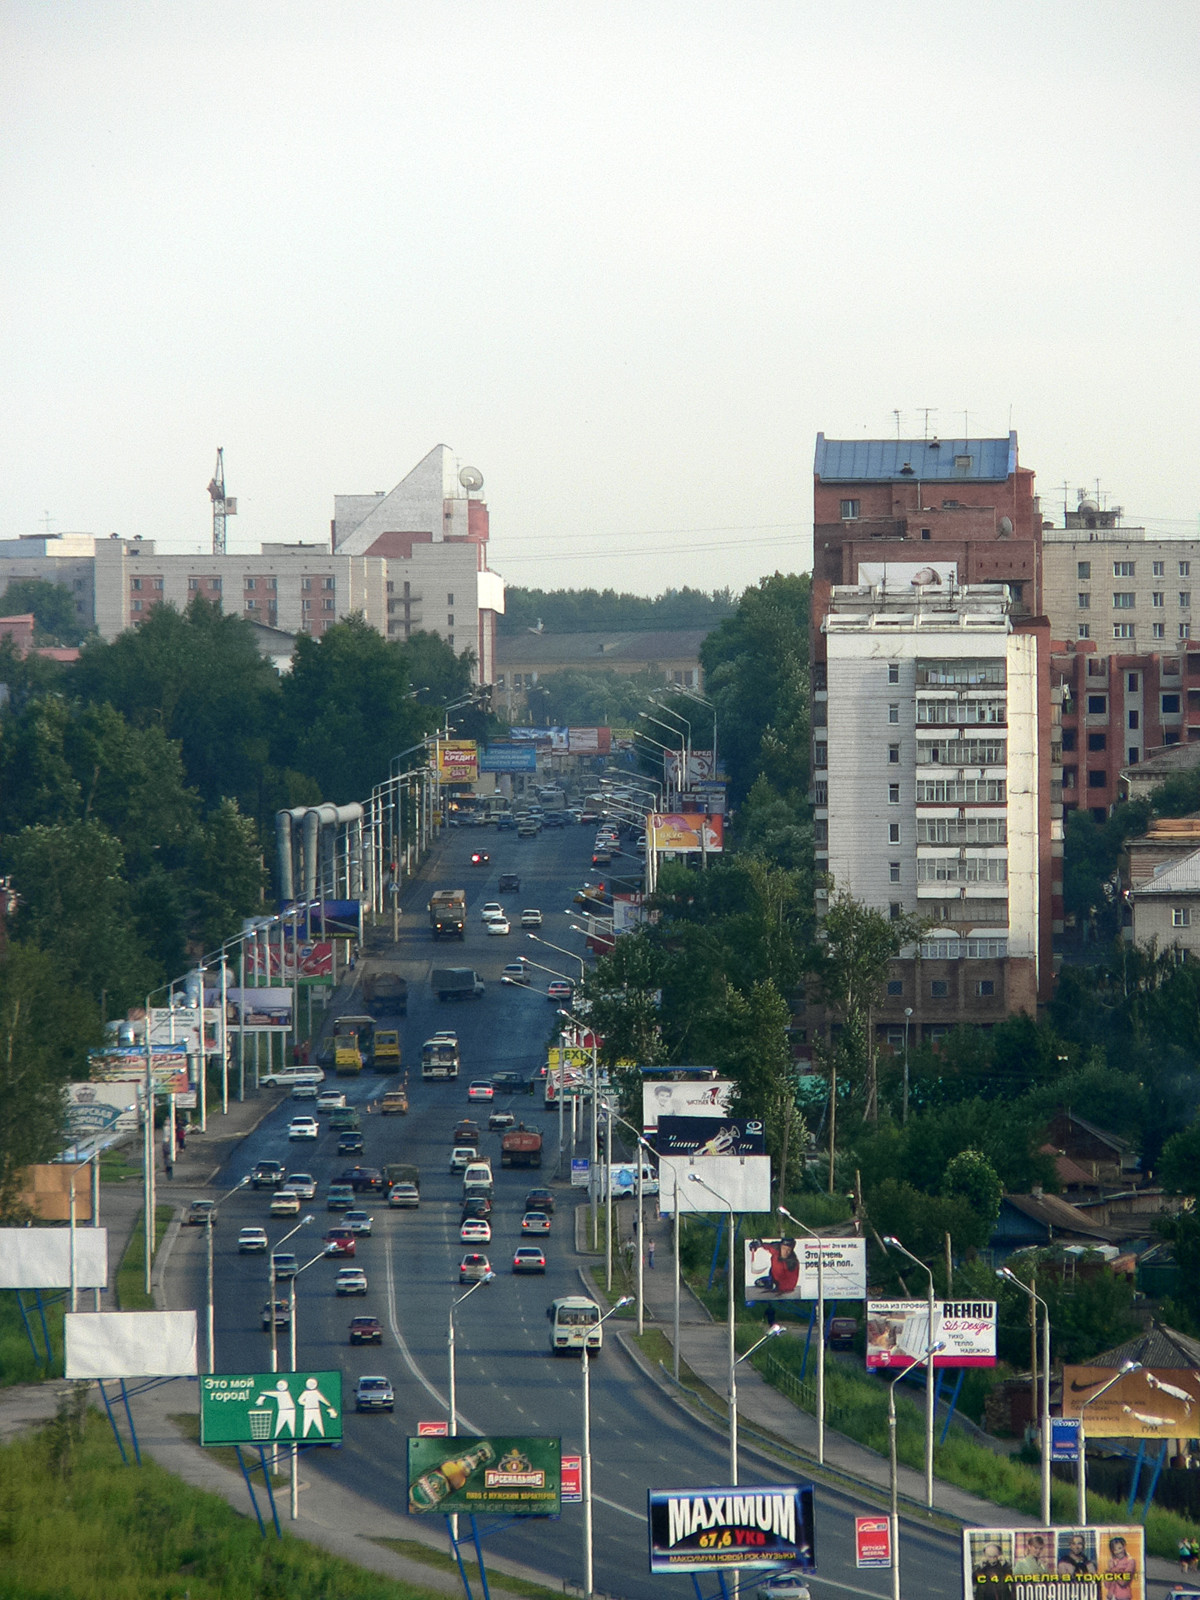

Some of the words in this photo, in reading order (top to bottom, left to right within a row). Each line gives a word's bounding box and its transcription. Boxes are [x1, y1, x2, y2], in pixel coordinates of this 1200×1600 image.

[805, 1250, 819, 1259] Это
[804, 1260, 835, 1269] ровый
[943, 1303, 993, 1318] REHAU
[204, 1378, 228, 1389] Это
[230, 1377, 255, 1388] мой
[210, 1389, 250, 1402] город!
[668, 1494, 796, 1548] MAXIMUM
[699, 1531, 732, 1549] 67,6
[734, 1530, 766, 1545] УКВ
[669, 1554, 716, 1562] МАКСИМУМ
[717, 1552, 744, 1561] НОВОЙ
[745, 1551, 796, 1560] РОК-МУЗЫКИ
[977, 1575, 987, 1584] С
[990, 1575, 999, 1583] 4
[1004, 1574, 1059, 1582] АПРЕЛЯ
[1061, 1573, 1071, 1581] В
[1075, 1572, 1131, 1581] ТОМСКЕ
